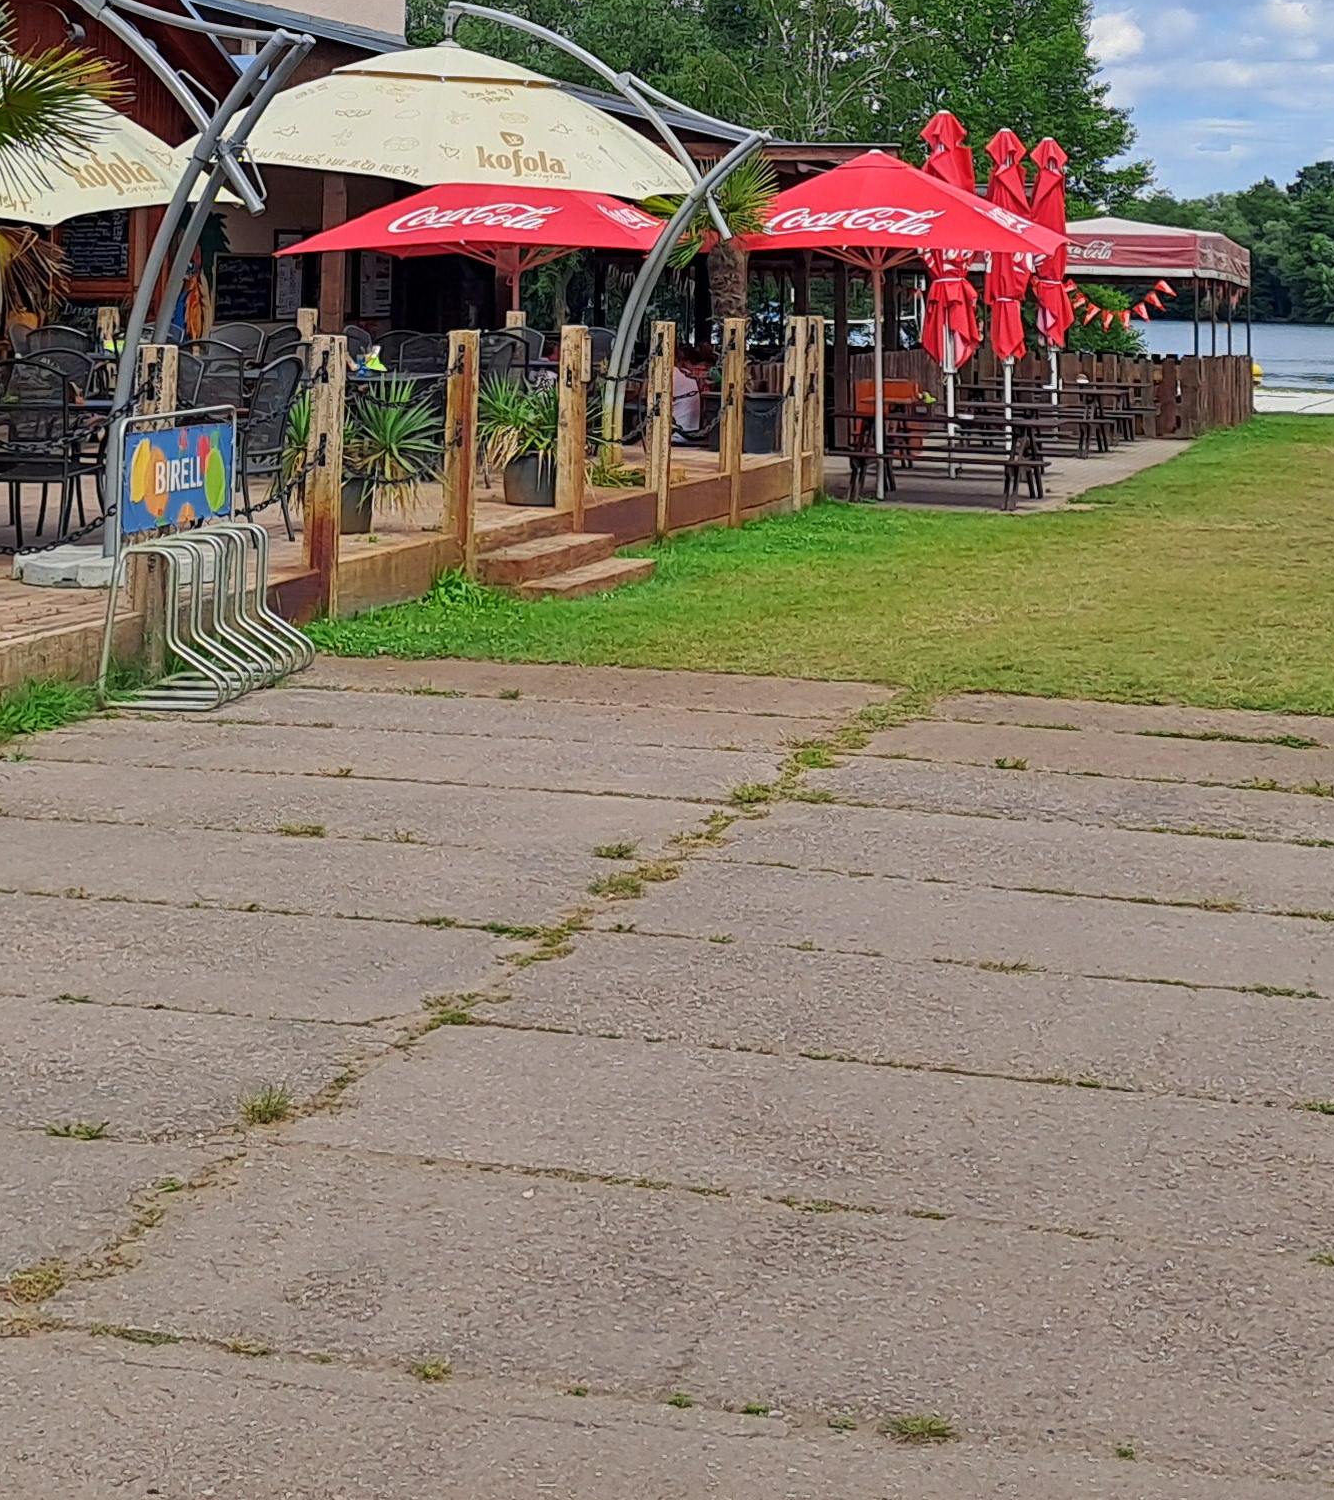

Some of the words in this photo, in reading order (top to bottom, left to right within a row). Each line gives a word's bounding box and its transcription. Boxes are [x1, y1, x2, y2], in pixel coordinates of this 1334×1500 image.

[66, 151, 158, 196] kofola
[476, 146, 566, 177] kofola
[524, 171, 571, 183] original
[127, 178, 170, 198] original
[387, 203, 565, 232] Coca-Cola
[763, 206, 947, 237] Coca-Cola
[155, 456, 204, 495] BIRELL
